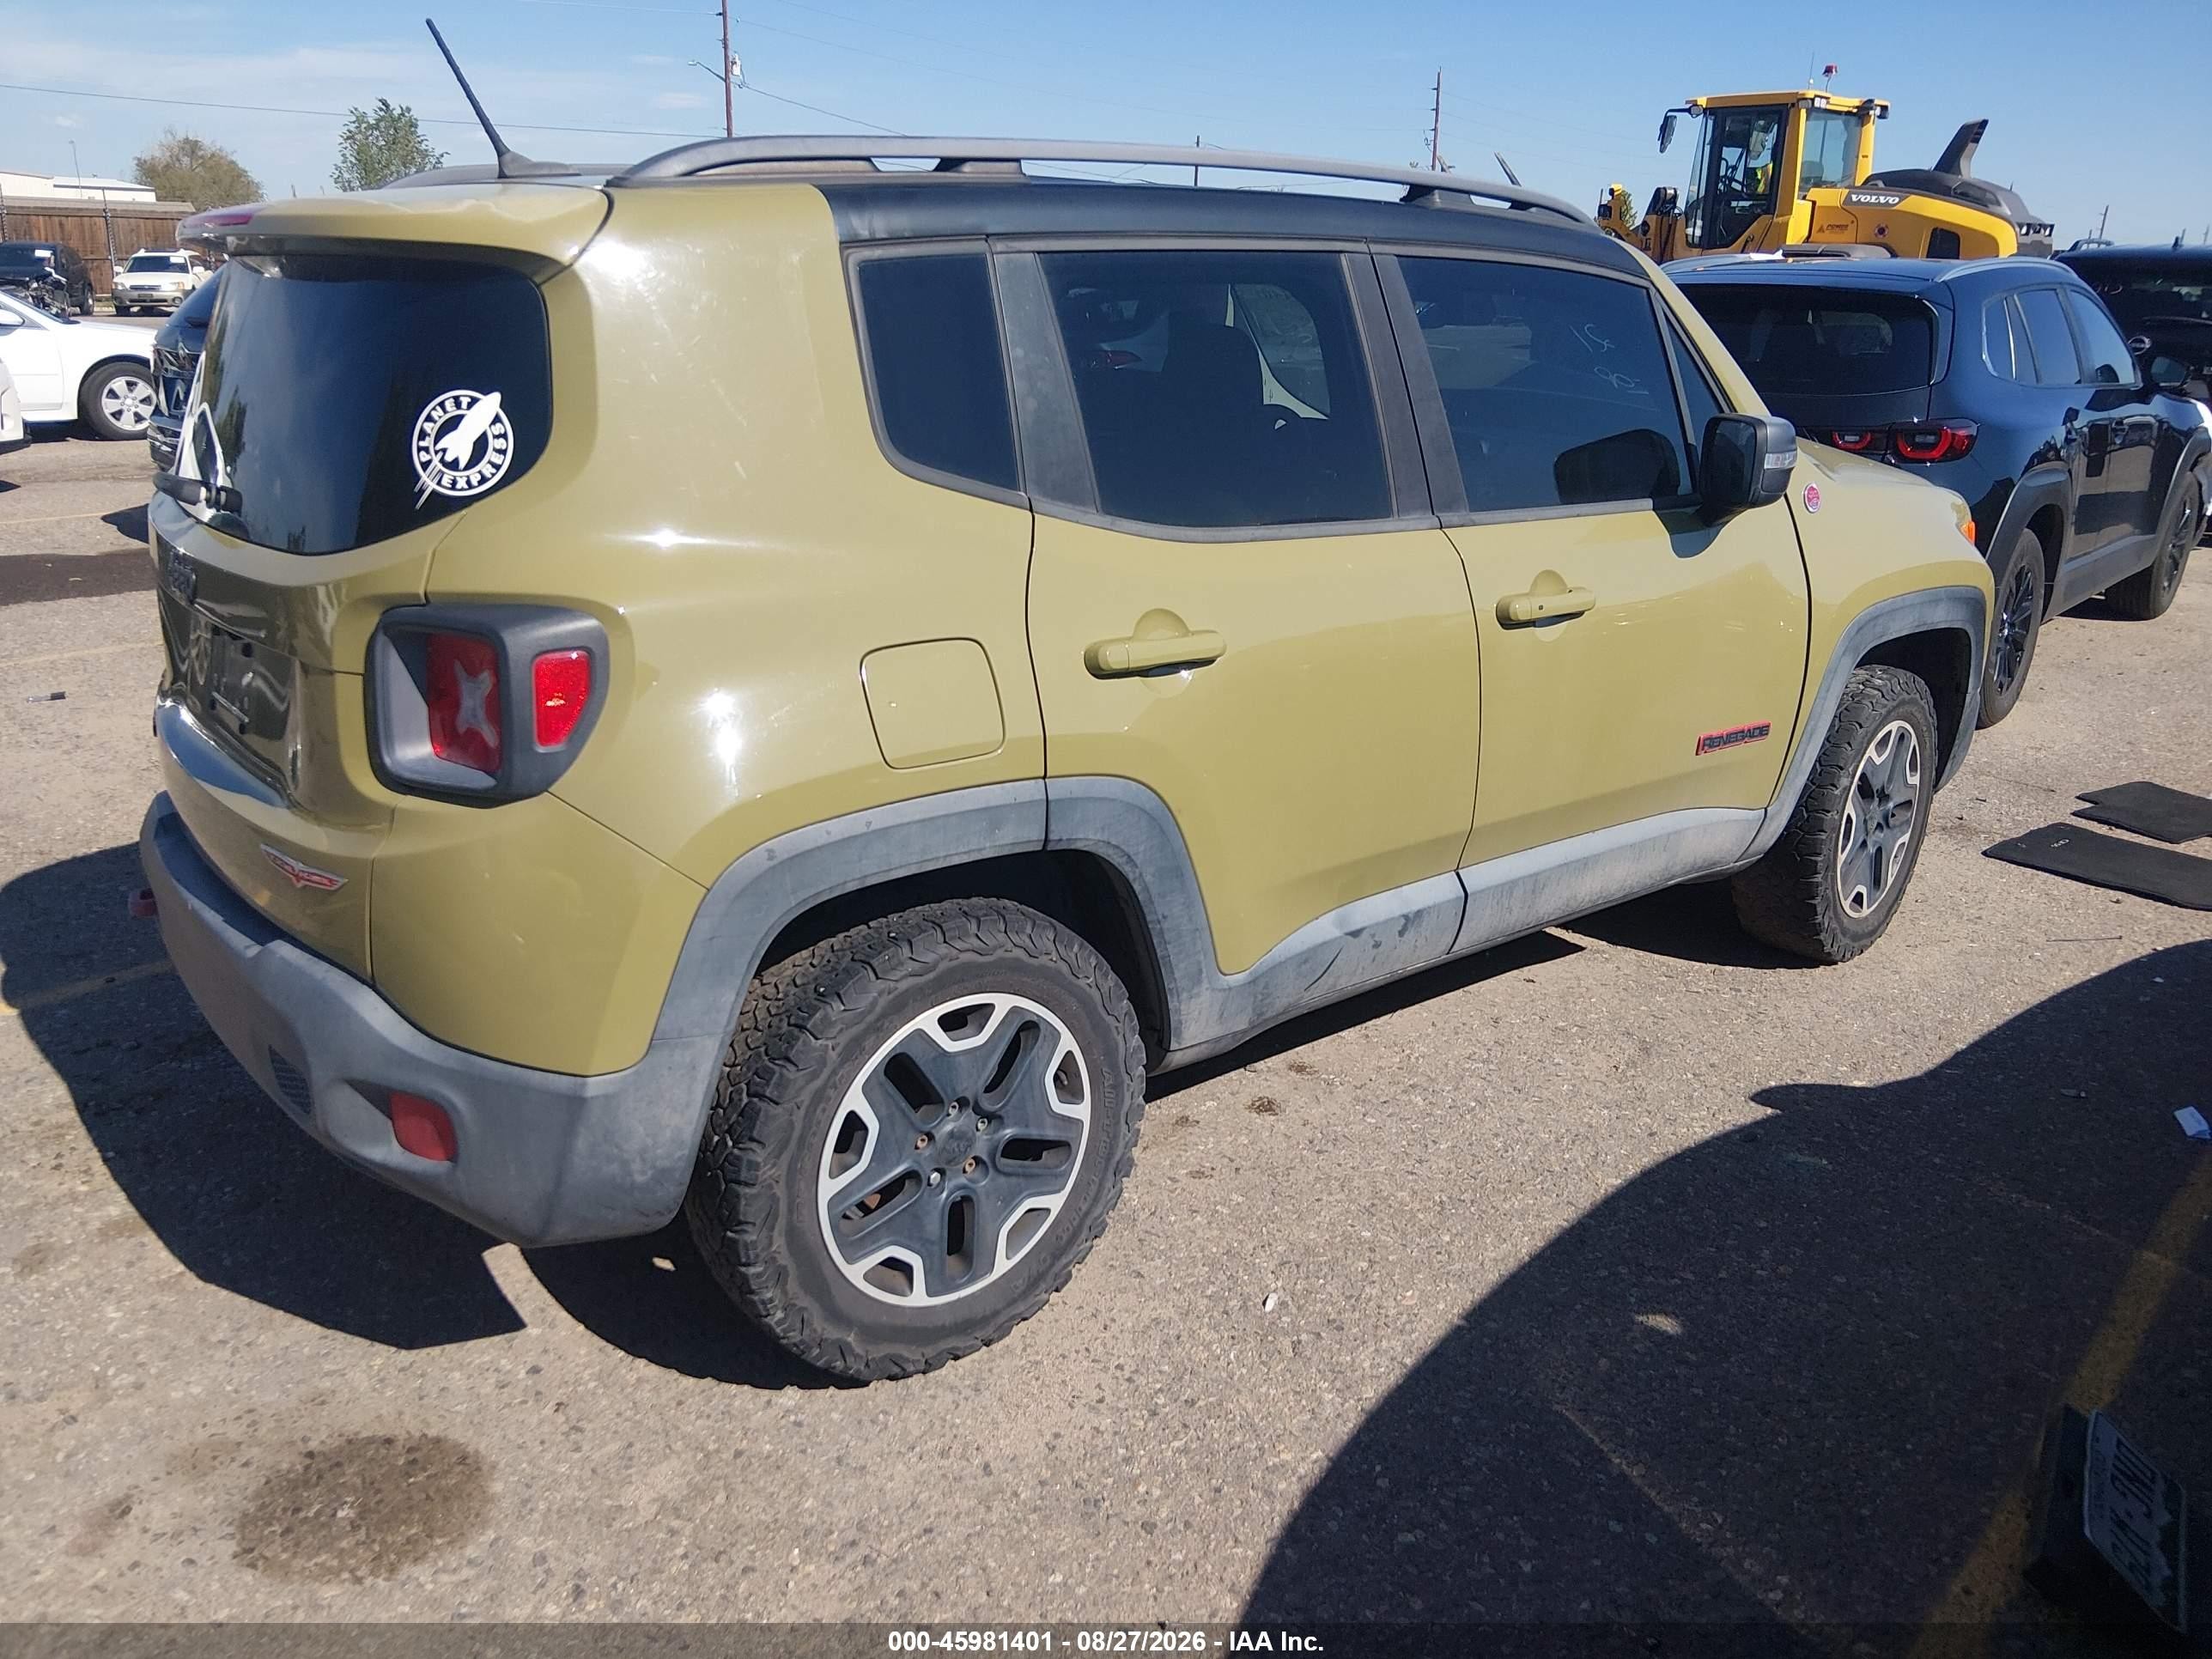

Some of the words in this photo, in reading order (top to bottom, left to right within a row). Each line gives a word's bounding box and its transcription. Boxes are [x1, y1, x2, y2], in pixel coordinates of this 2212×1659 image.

[1850, 194, 1900, 204] VOLVO
[417, 396, 471, 463] PLANET
[441, 422, 507, 489] EXPRESS
[1698, 723, 1771, 754] RENEGADE
